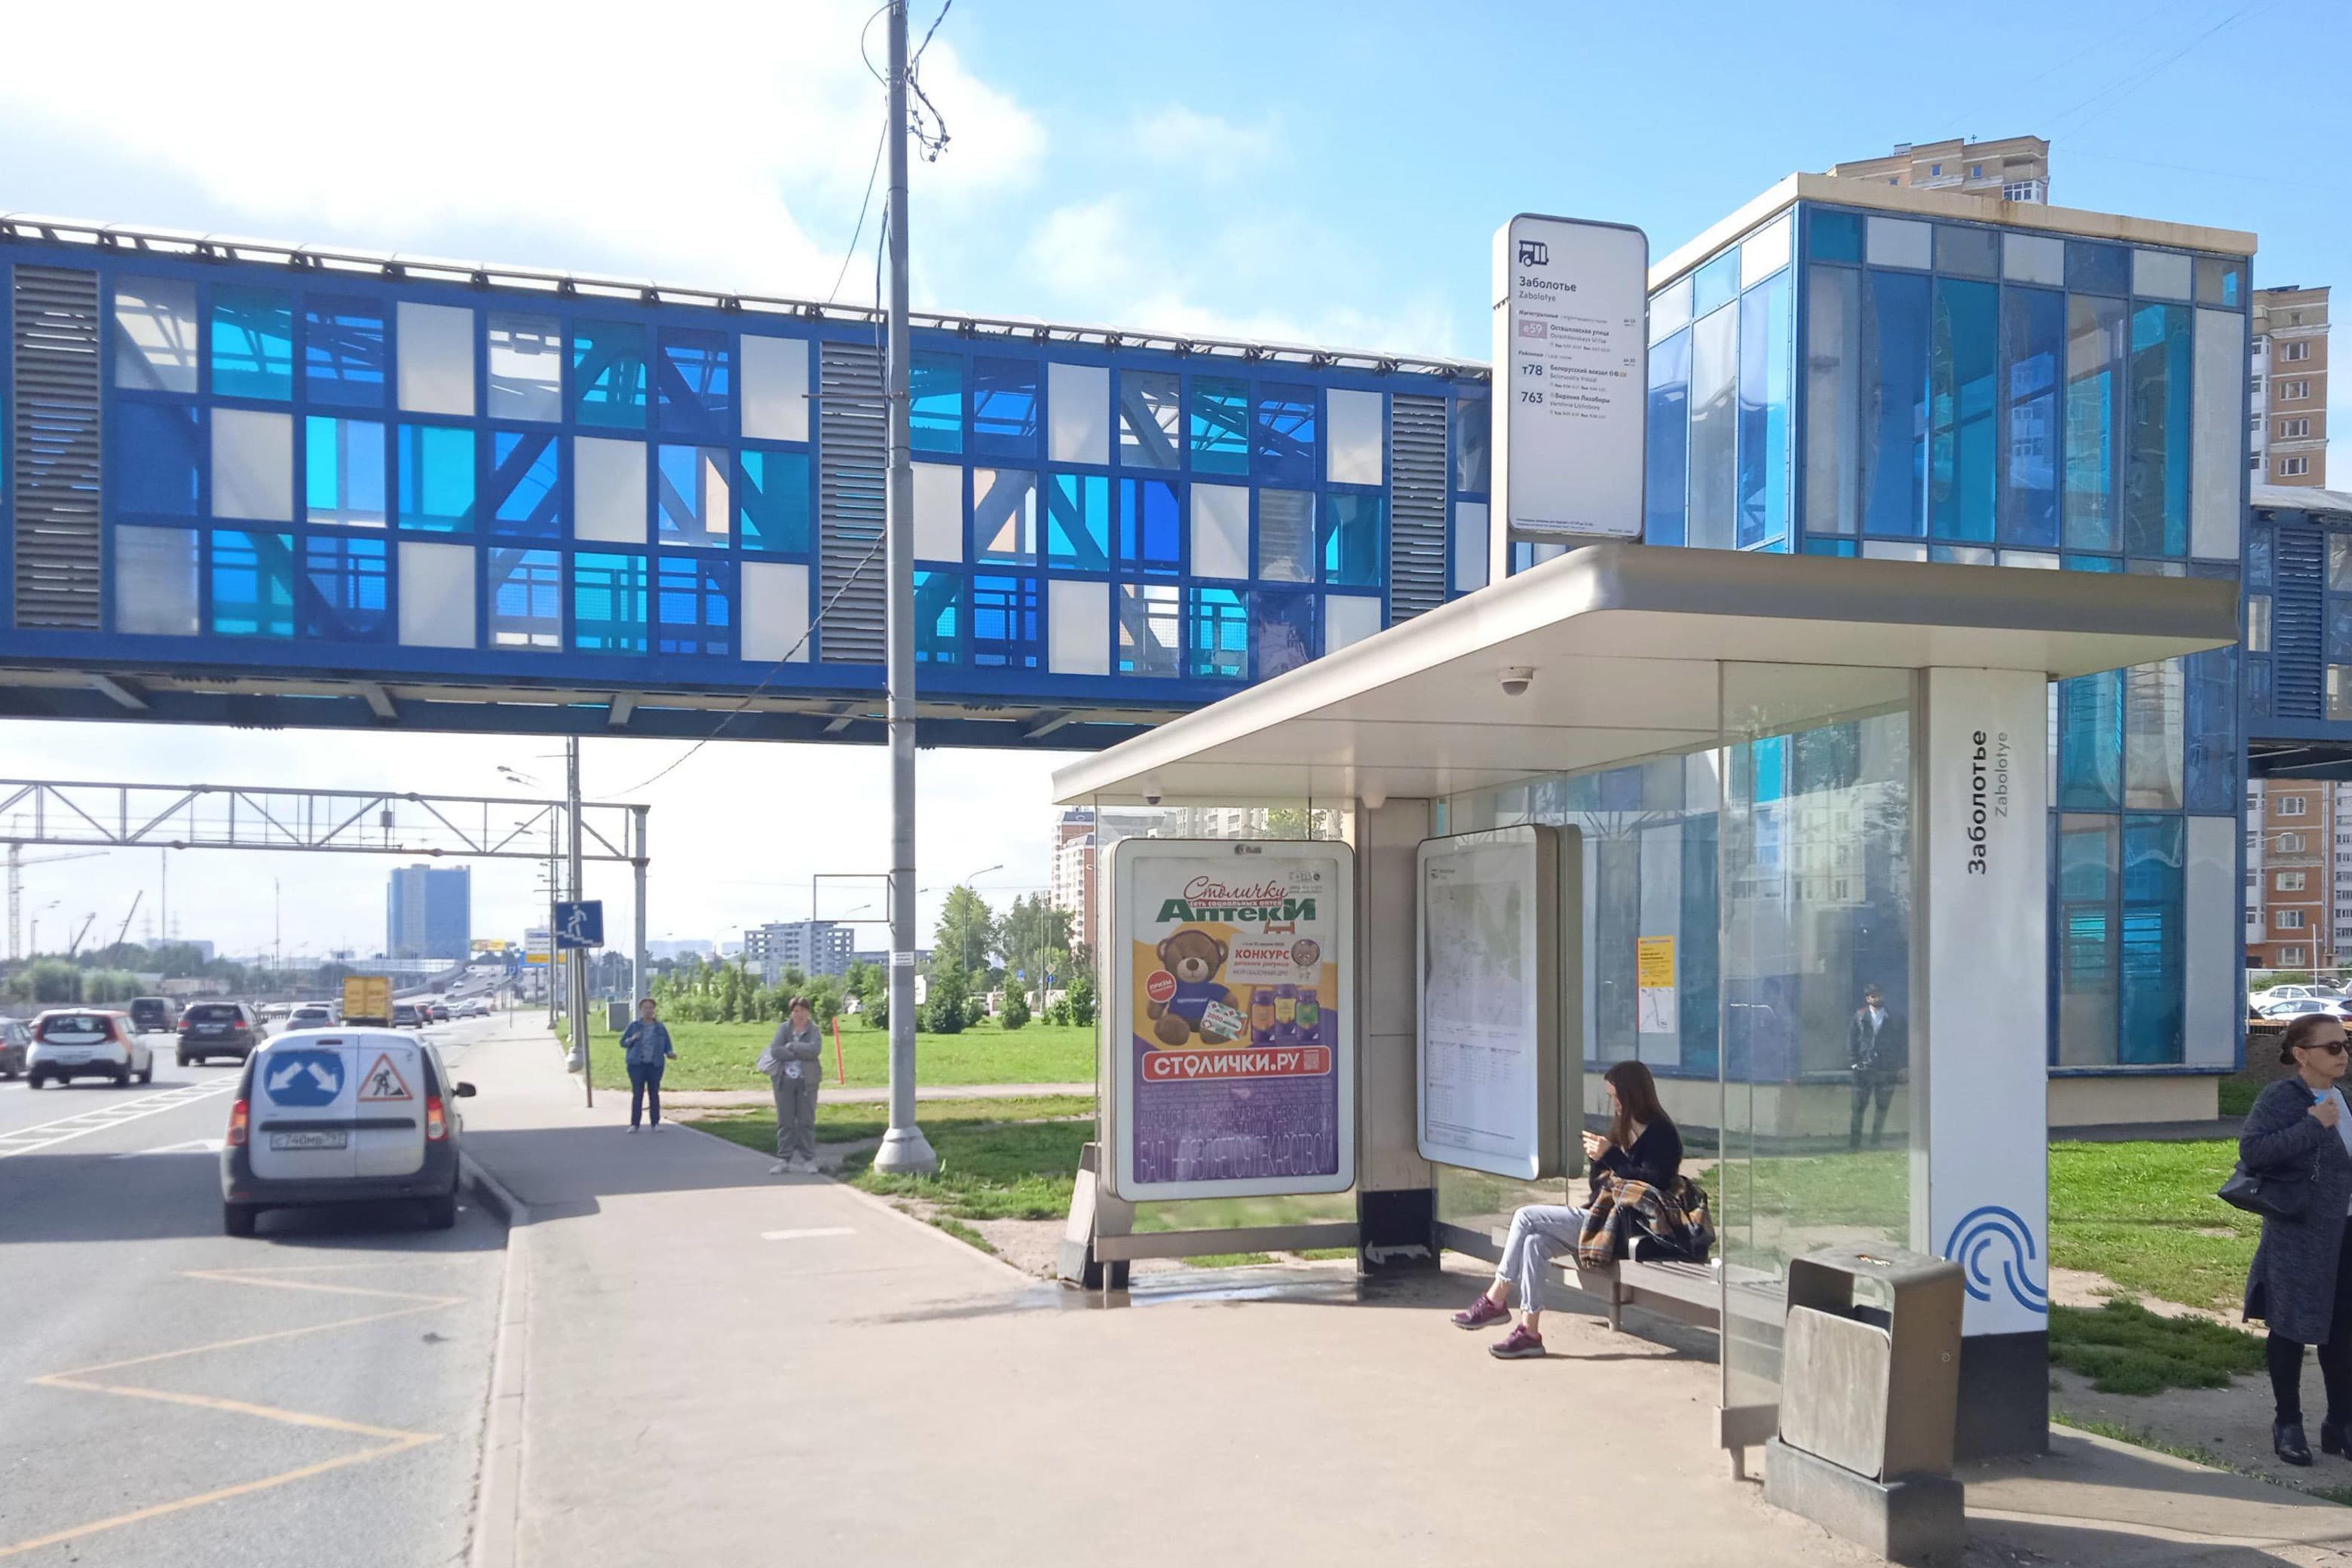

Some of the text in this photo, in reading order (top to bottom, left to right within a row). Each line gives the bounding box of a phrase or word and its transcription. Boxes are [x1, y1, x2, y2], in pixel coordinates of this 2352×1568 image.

[1519, 276, 1577, 292] Заболотье
[1519, 291, 1557, 303] Zabolotye
[1550, 324, 1591, 334] Осташковская
[1522, 363, 1543, 375] т78
[1550, 364, 1588, 374] Белорусский
[1521, 391, 1543, 404] 763
[1580, 395, 1610, 405] Лихоборы
[1995, 731, 2011, 818] Zabolotye
[1967, 730, 1987, 875] Заболотье
[1183, 875, 1290, 900] Столички
[1235, 949, 1291, 960] КОНКУРС
[1153, 1052, 1300, 1077] СТОЛИЧКИ.РУ
